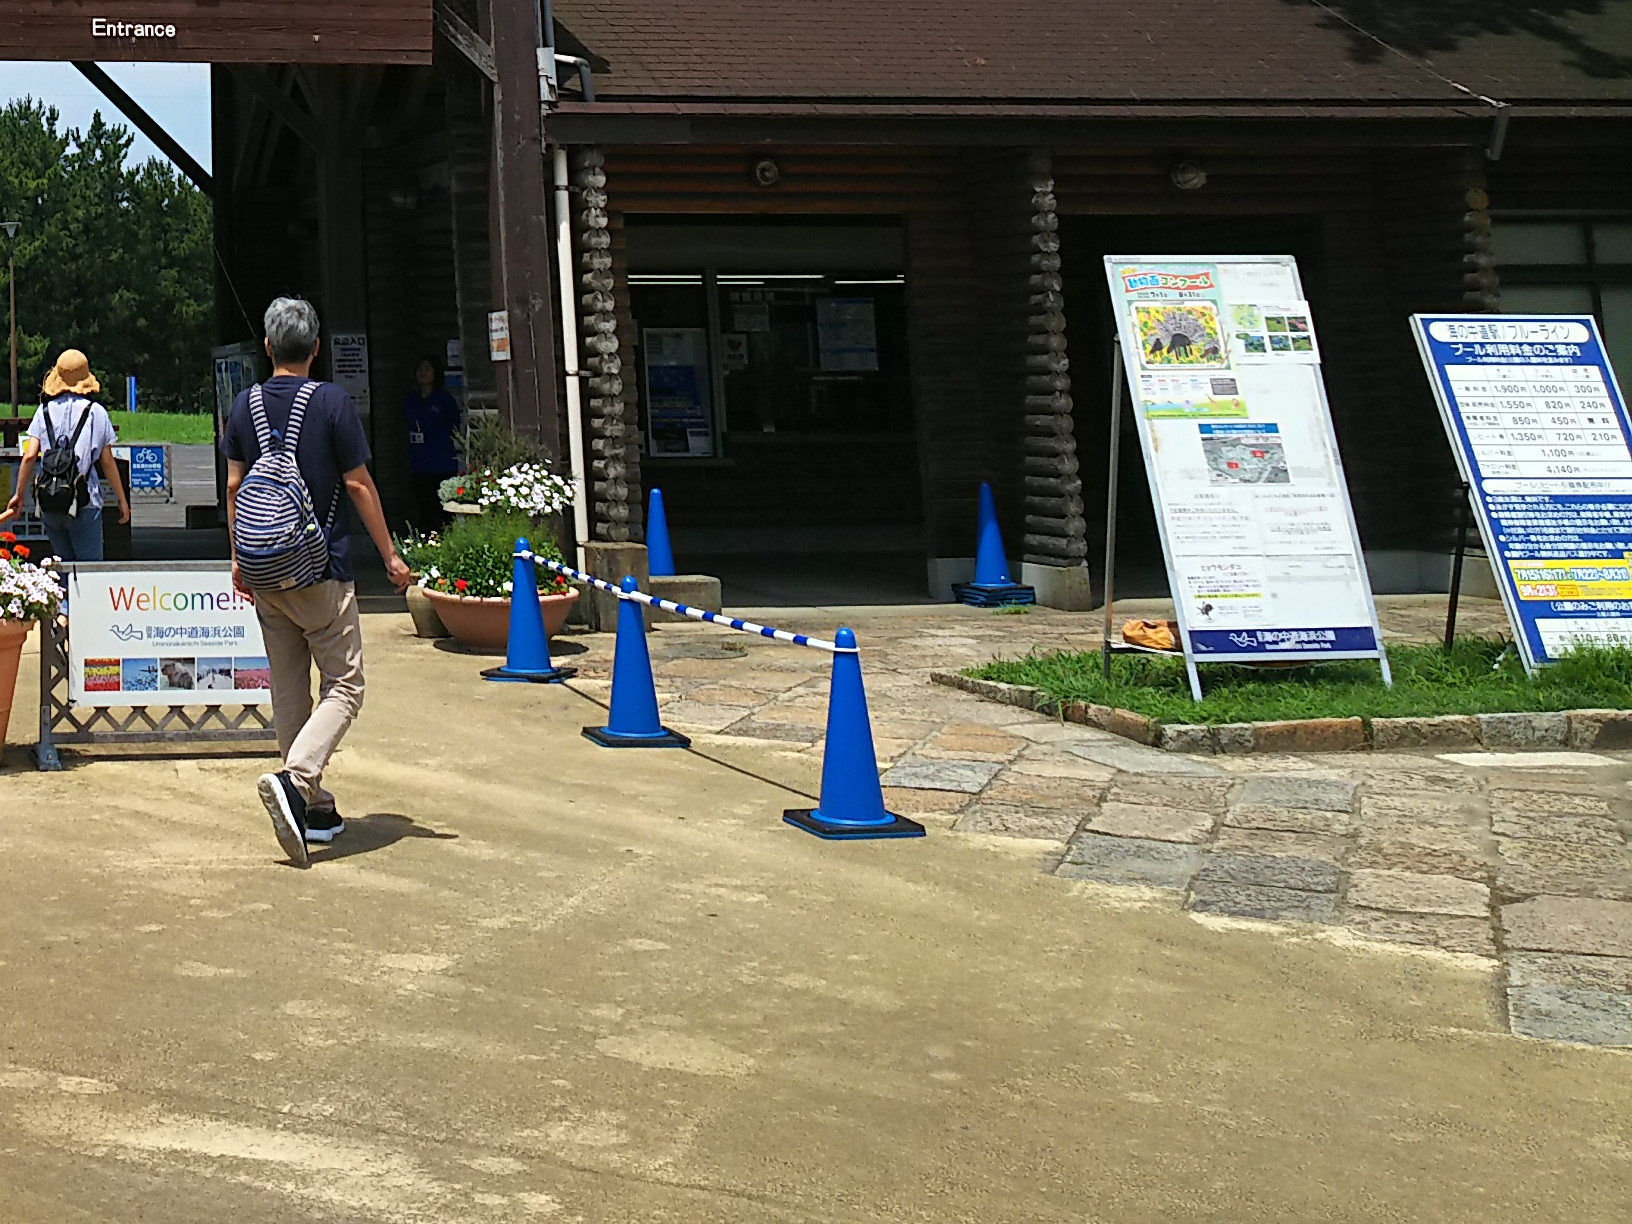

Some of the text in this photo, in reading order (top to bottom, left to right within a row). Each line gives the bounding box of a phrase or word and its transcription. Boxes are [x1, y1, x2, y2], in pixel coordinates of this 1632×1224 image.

[92, 17, 177, 37] Entrance
[1494, 384, 1527, 393] 1,900円
[1532, 384, 1566, 393] 1,000円
[1574, 384, 1601, 393] 300円
[1499, 400, 1533, 409] 1,550円
[1579, 400, 1607, 409] 240円
[1512, 416, 1539, 425] 850円
[1551, 416, 1577, 425] 450円
[1510, 432, 1545, 441] 1,350円
[1555, 432, 1583, 441] 720円
[1591, 432, 1618, 441] 210円
[1541, 449, 1575, 458] 1,100円
[1546, 465, 1581, 474] 4,140円
[109, 585, 244, 611] Welcome!!
